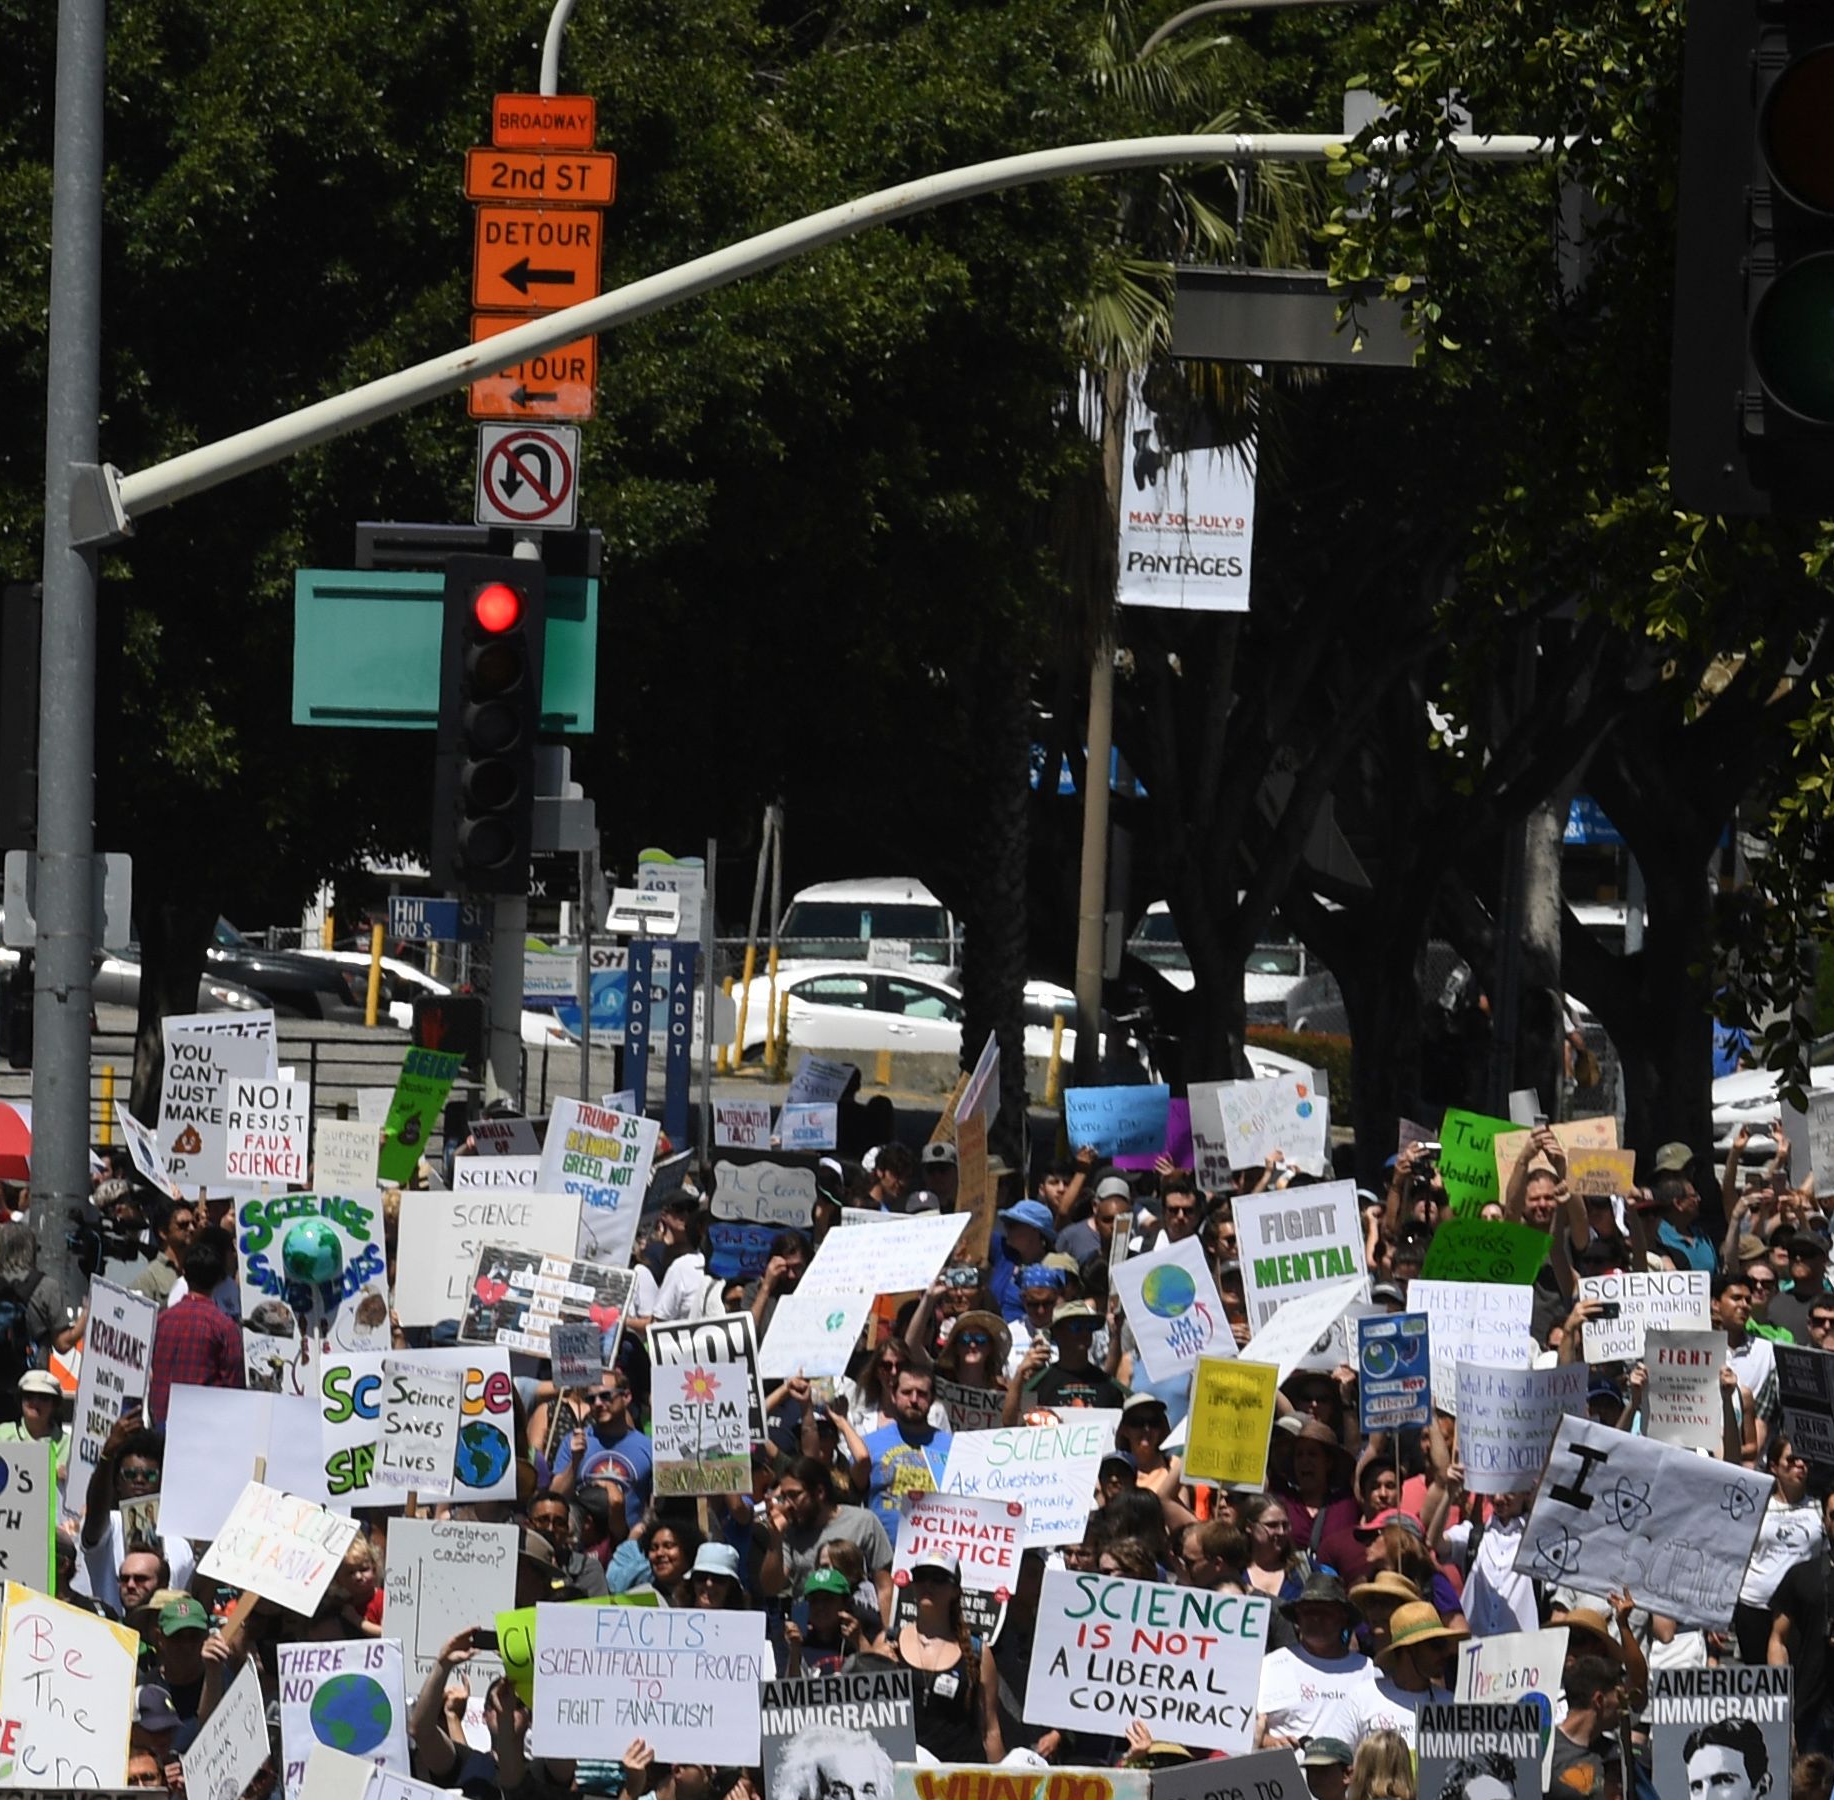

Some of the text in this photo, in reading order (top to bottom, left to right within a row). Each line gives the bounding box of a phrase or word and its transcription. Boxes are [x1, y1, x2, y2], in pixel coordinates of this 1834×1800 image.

[499, 112, 589, 130] BROADWAY
[491, 162, 592, 191] 2nd ST
[486, 221, 591, 246] DETOUR
[1127, 552, 1243, 577] PANTAGES
[170, 1042, 212, 1062] YOU
[169, 1063, 228, 1085] CAN'T
[166, 1085, 217, 1103] JUST
[238, 1086, 293, 1110] NO!
[165, 1104, 223, 1125] MAKE
[229, 1113, 304, 1131] RESIST
[244, 1134, 292, 1150] FAUX
[227, 1152, 301, 1178] SCIENCE!
[1259, 1204, 1337, 1244] FIGHT
[1253, 1245, 1358, 1289] MENTAL
[1064, 1575, 1267, 1638] SCIENCE
[595, 1609, 720, 1647] FACTS:
[1077, 1623, 1218, 1660] IS NOT
[539, 1648, 763, 1681] SCIENTIFICALLY PROVEN
[1049, 1647, 1228, 1695] A LIBERAL
[630, 1678, 662, 1699] TO
[764, 1671, 912, 1709] AMERICAN
[1655, 1669, 1789, 1696] AMERICAN
[557, 1699, 713, 1728] FIGHT FANATICISM
[761, 1699, 911, 1737] IMMIGRANT
[1069, 1688, 1254, 1732] CONSPIRACY
[1420, 1705, 1540, 1732] AMERICAN
[1653, 1695, 1789, 1724] IMMIGRANT
[1419, 1732, 1540, 1759] IMMIGRANT
